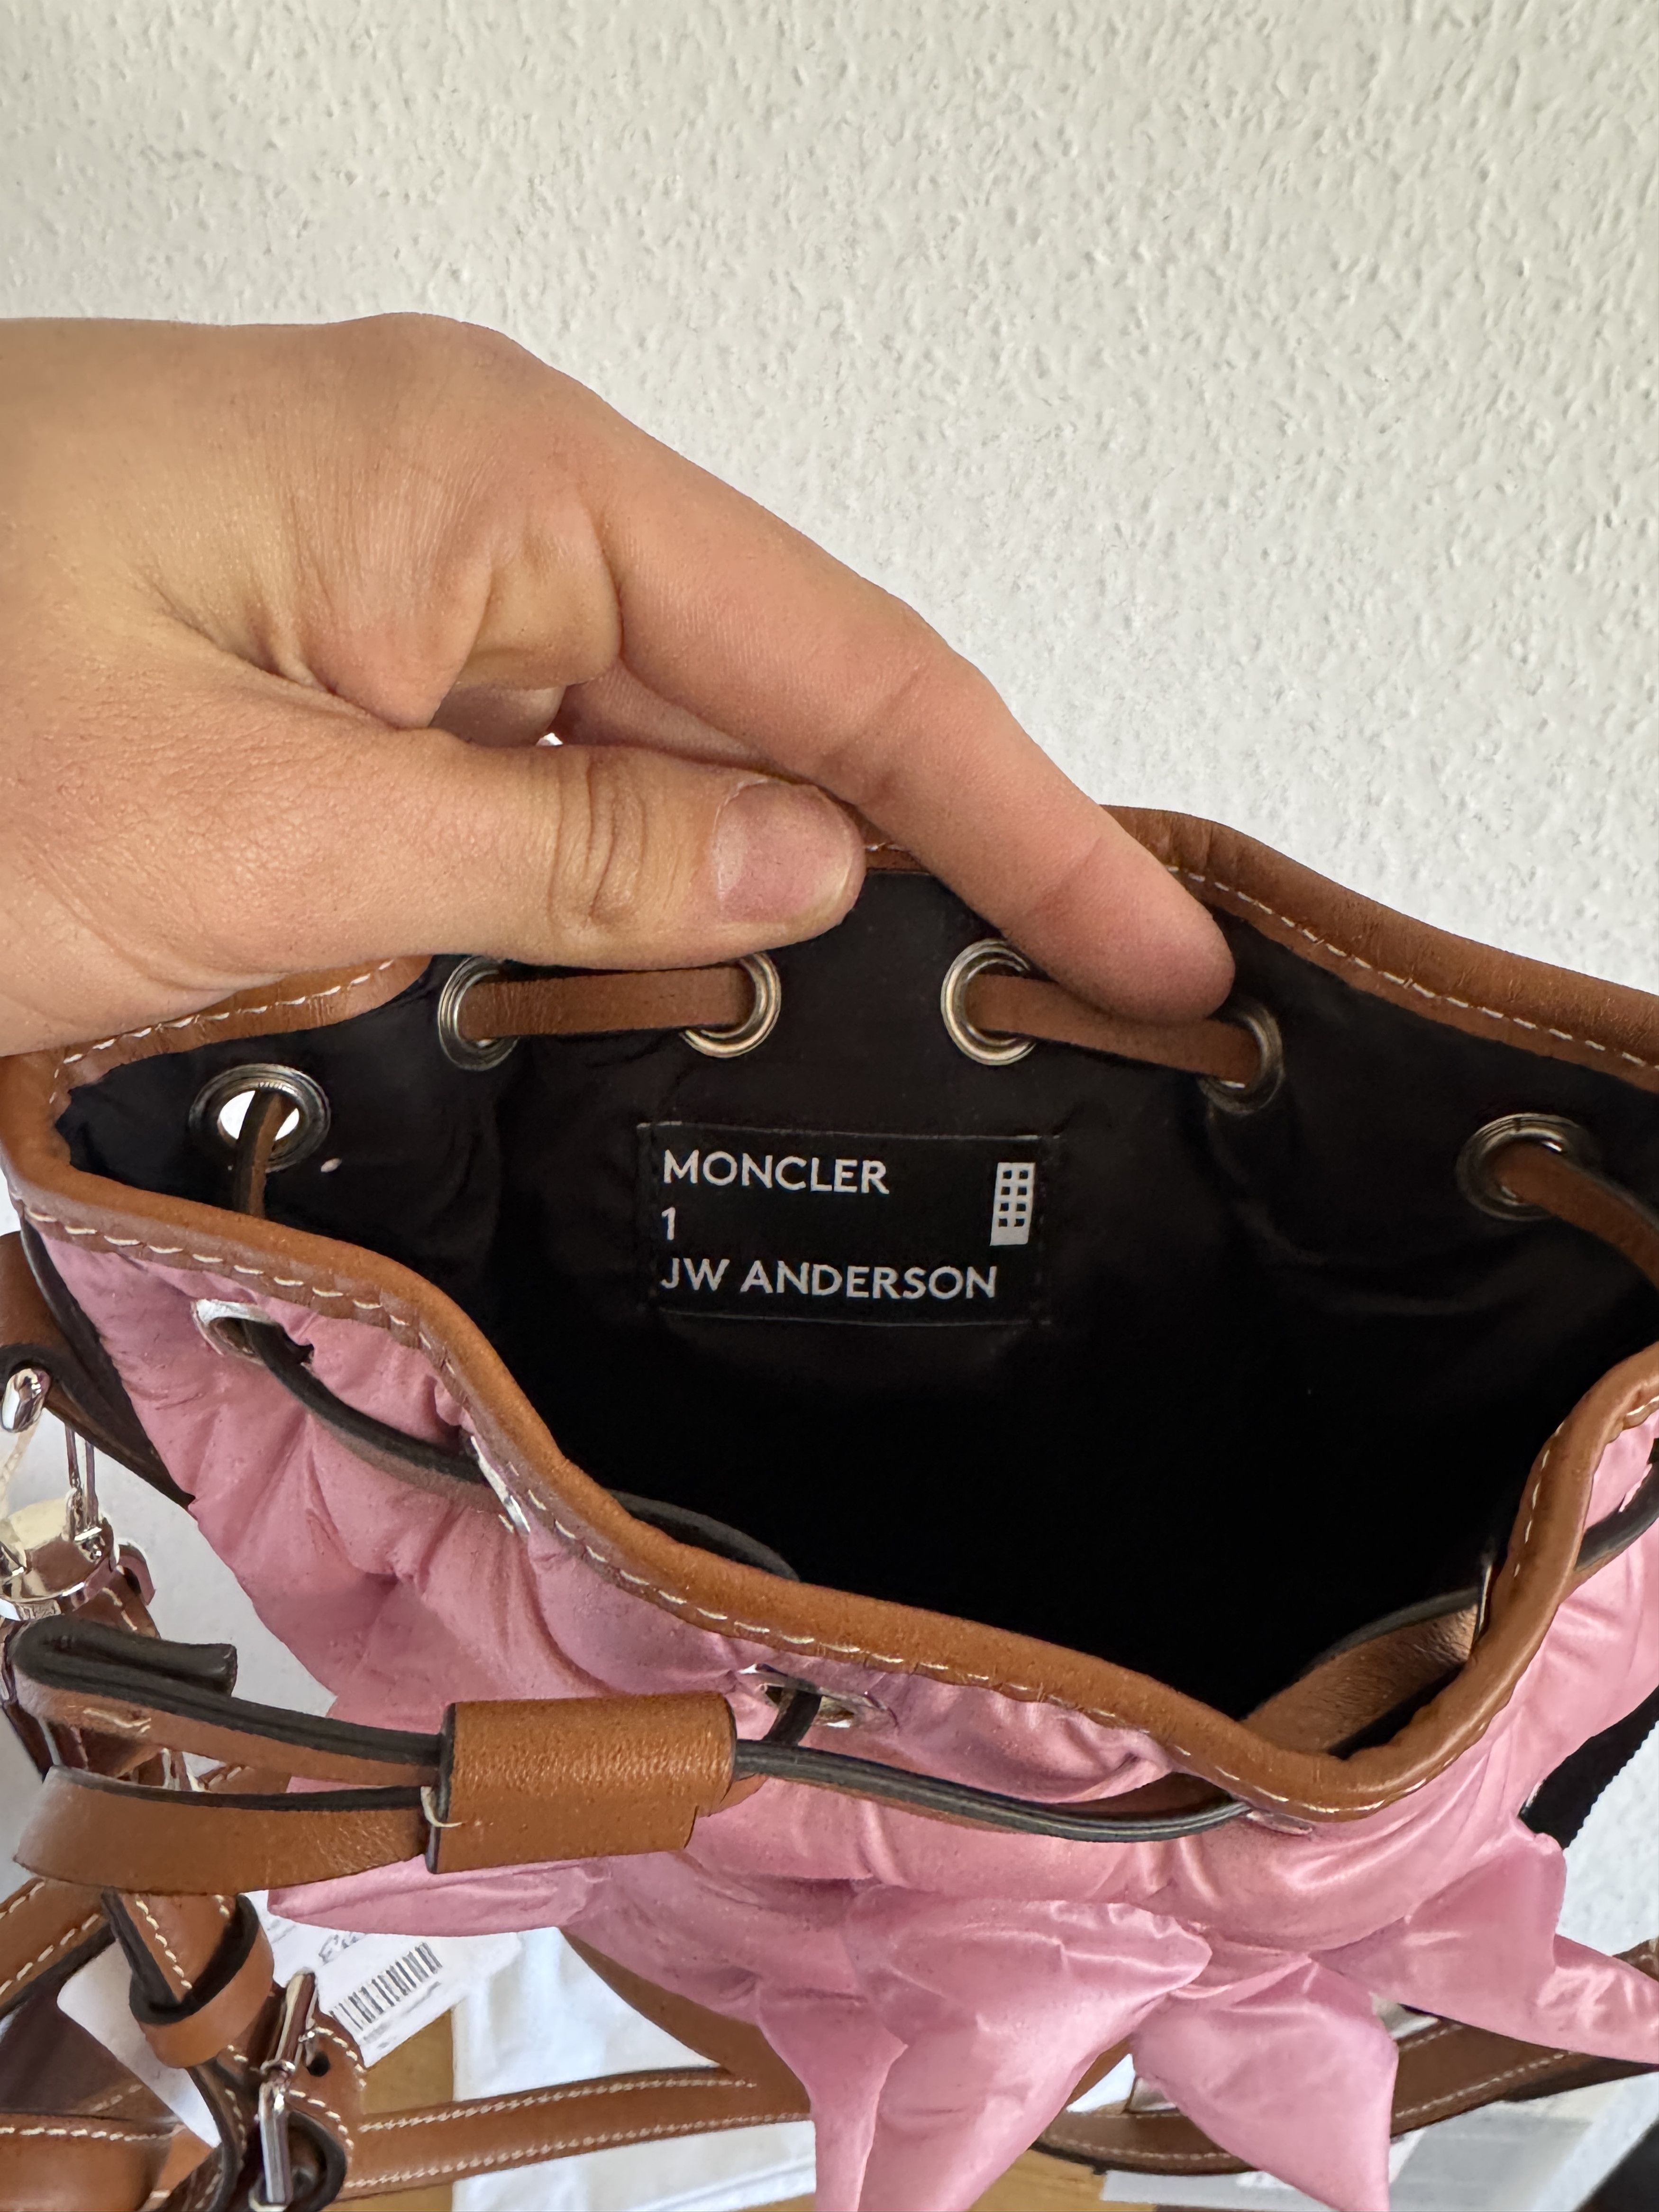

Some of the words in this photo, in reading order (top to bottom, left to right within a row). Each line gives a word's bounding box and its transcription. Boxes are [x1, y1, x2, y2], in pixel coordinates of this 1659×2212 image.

[664, 1149, 890, 1194] MONCLER
[661, 1207, 676, 1240] 1
[661, 1257, 730, 1291] JW
[740, 1260, 997, 1299] ANDERSON
